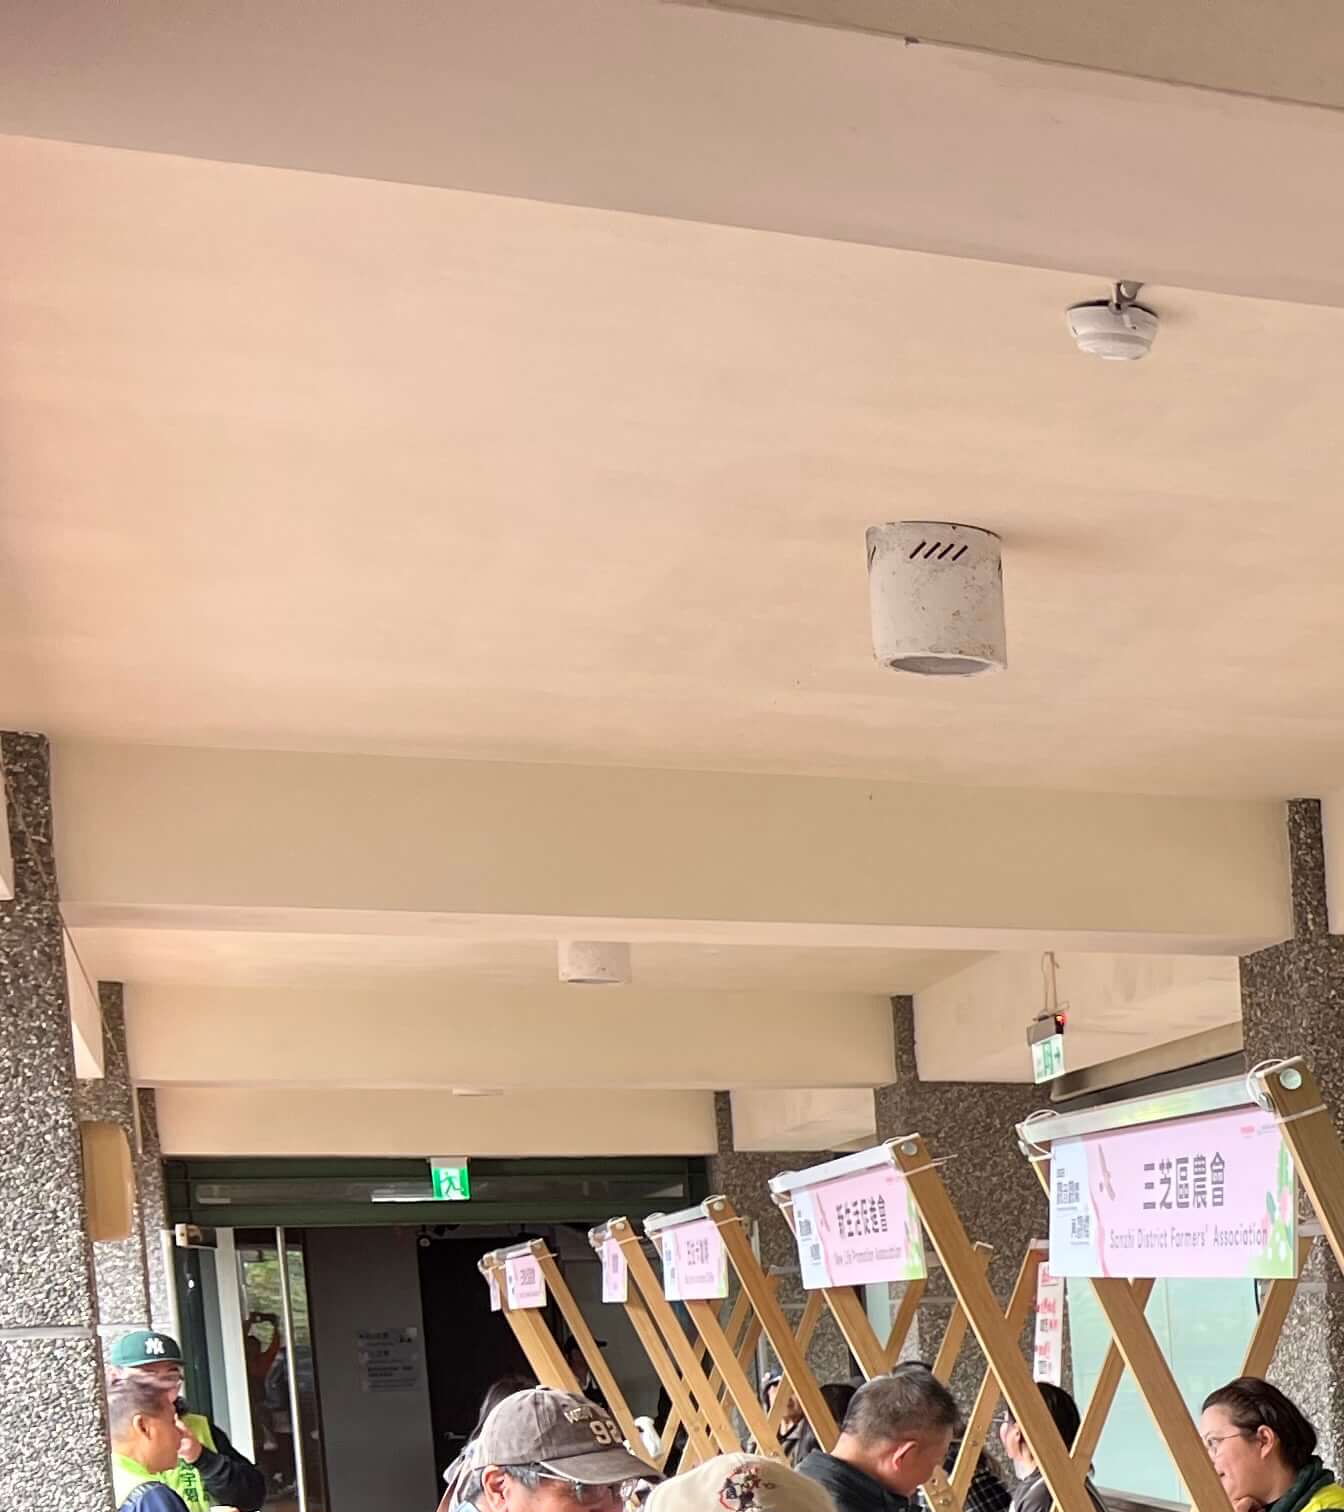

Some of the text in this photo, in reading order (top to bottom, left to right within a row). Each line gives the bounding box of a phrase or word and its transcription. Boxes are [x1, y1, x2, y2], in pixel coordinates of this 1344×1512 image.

[1143, 1152, 1225, 1210] 三芝區農會
[1110, 1228, 1135, 1249] Sanzhi
[1137, 1226, 1167, 1249] District
[1213, 1223, 1267, 1246] Association
